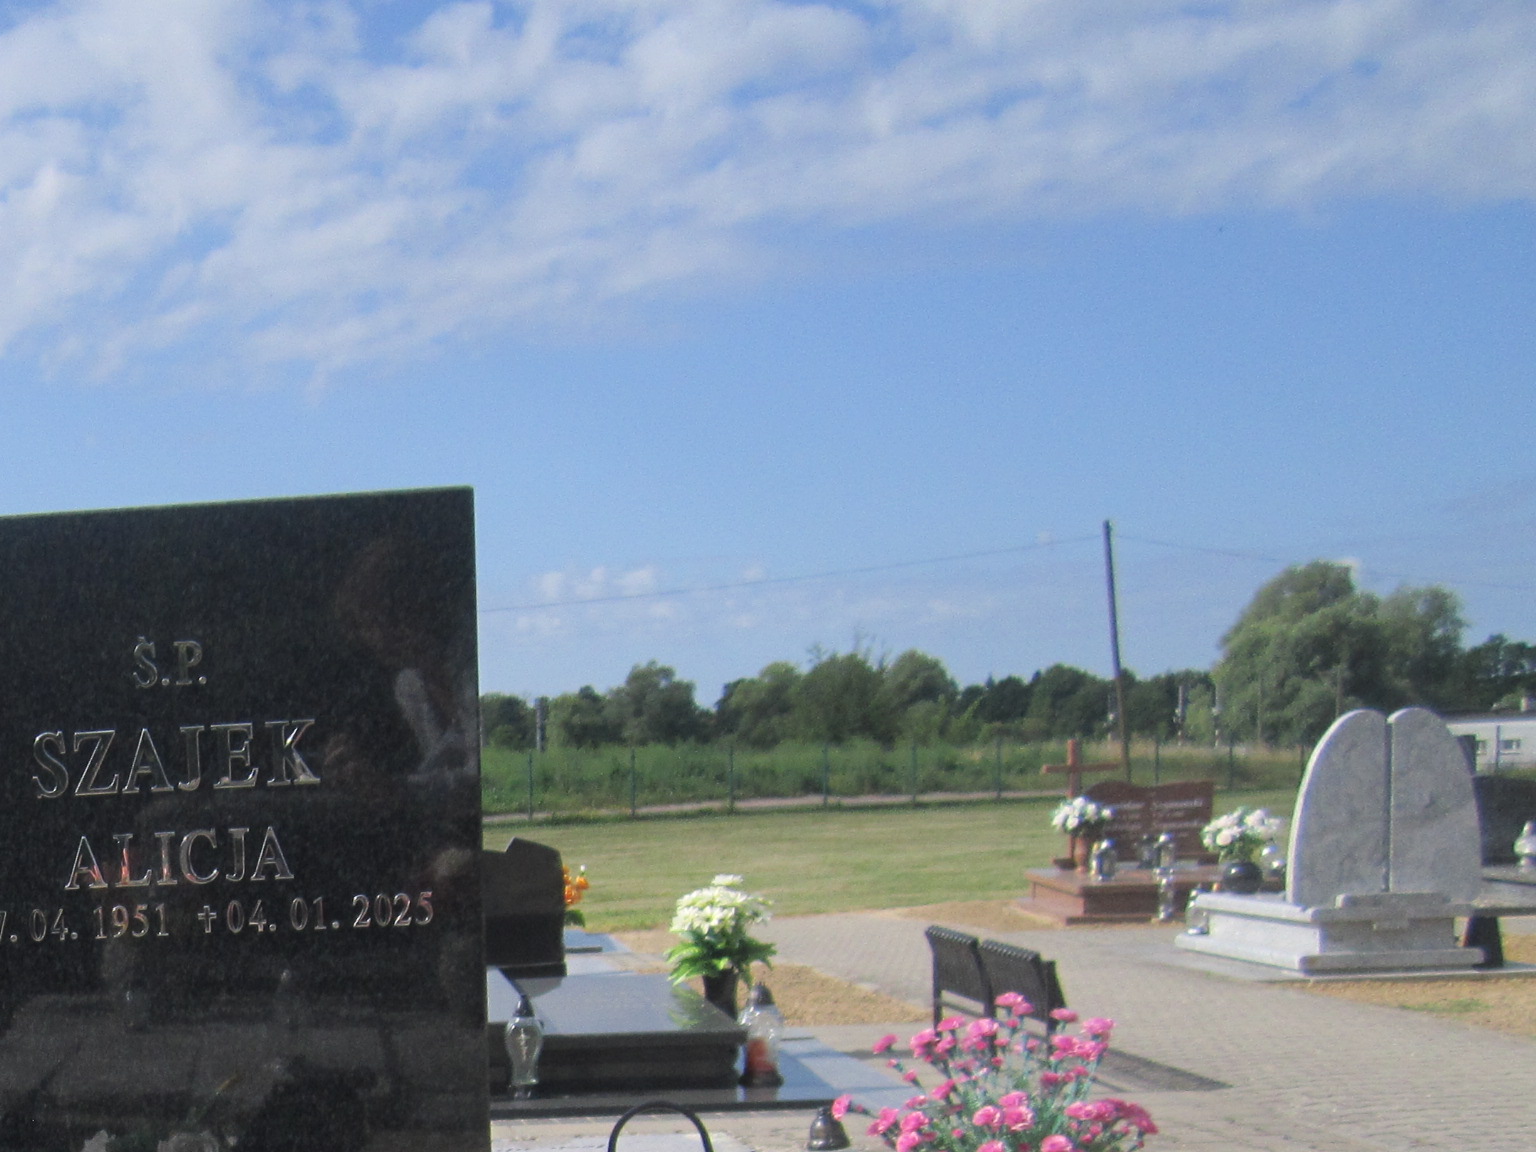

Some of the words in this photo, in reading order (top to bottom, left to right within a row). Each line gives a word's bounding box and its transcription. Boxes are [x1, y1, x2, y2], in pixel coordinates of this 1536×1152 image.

[31, 719, 321, 799] SZAJEK
[64, 826, 295, 890] ALICJA
[92, 903, 170, 940] 1951
[352, 891, 434, 928] 2025
